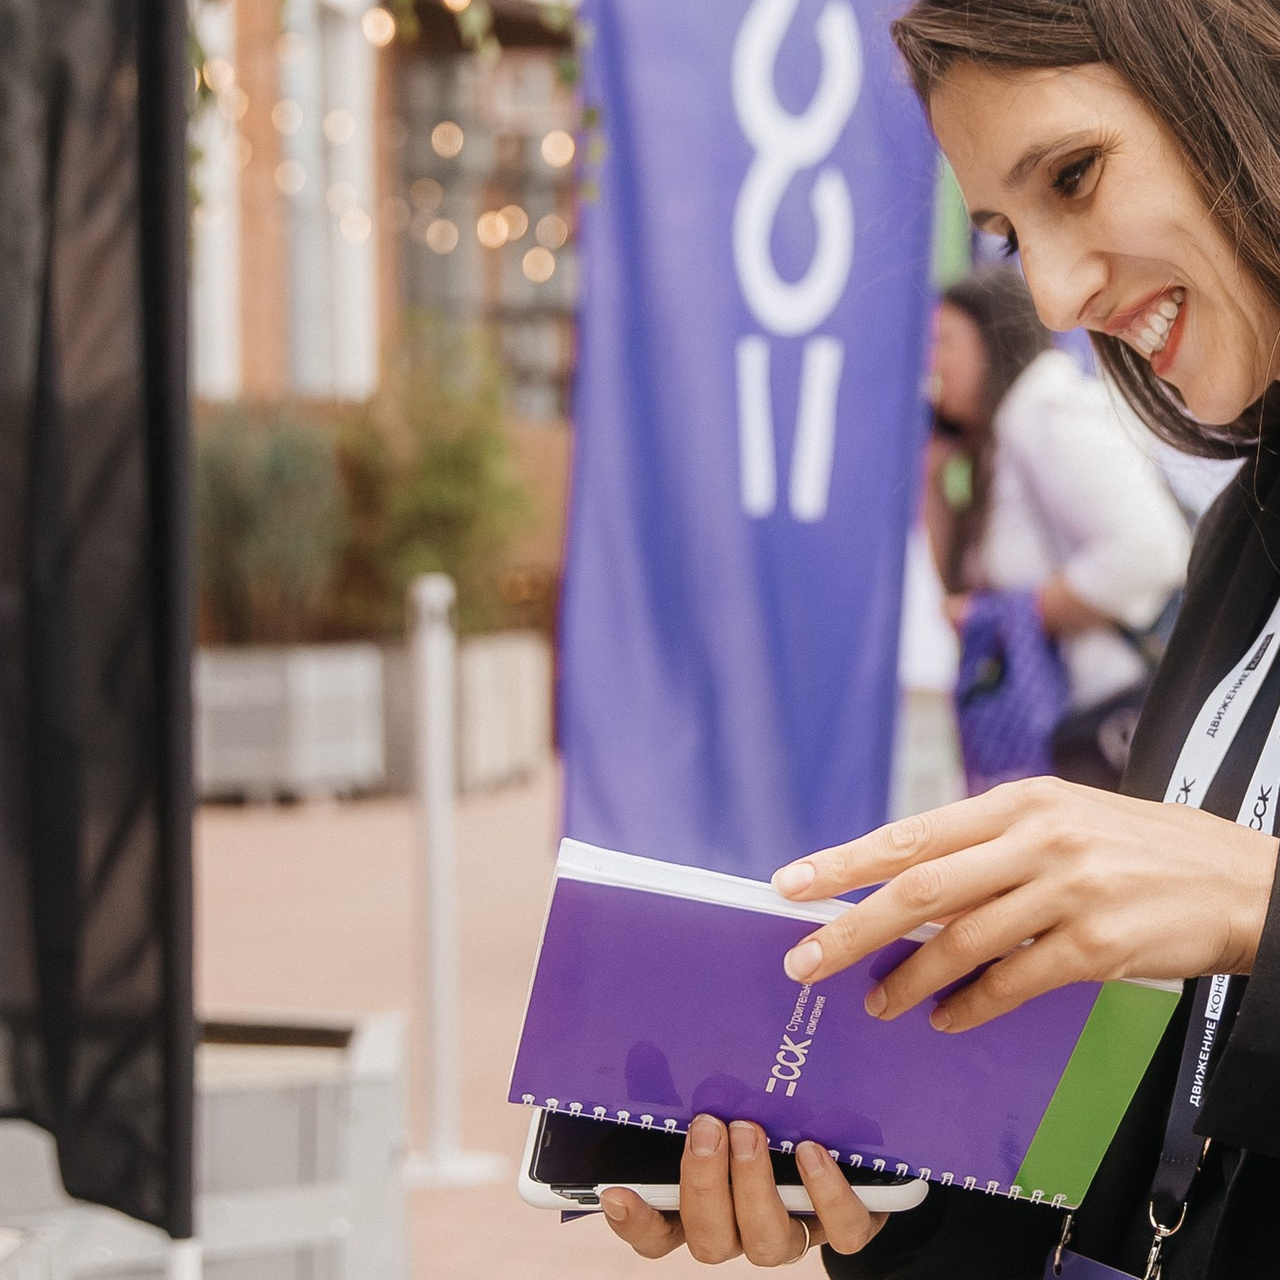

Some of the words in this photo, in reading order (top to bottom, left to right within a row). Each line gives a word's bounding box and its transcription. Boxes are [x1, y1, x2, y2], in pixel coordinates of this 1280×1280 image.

[1205, 670, 1251, 739] ДВИЖЕНИЕ
[805, 995, 827, 1036] компания
[1189, 1020, 1217, 1107] ДВИЖЕНИЕ
